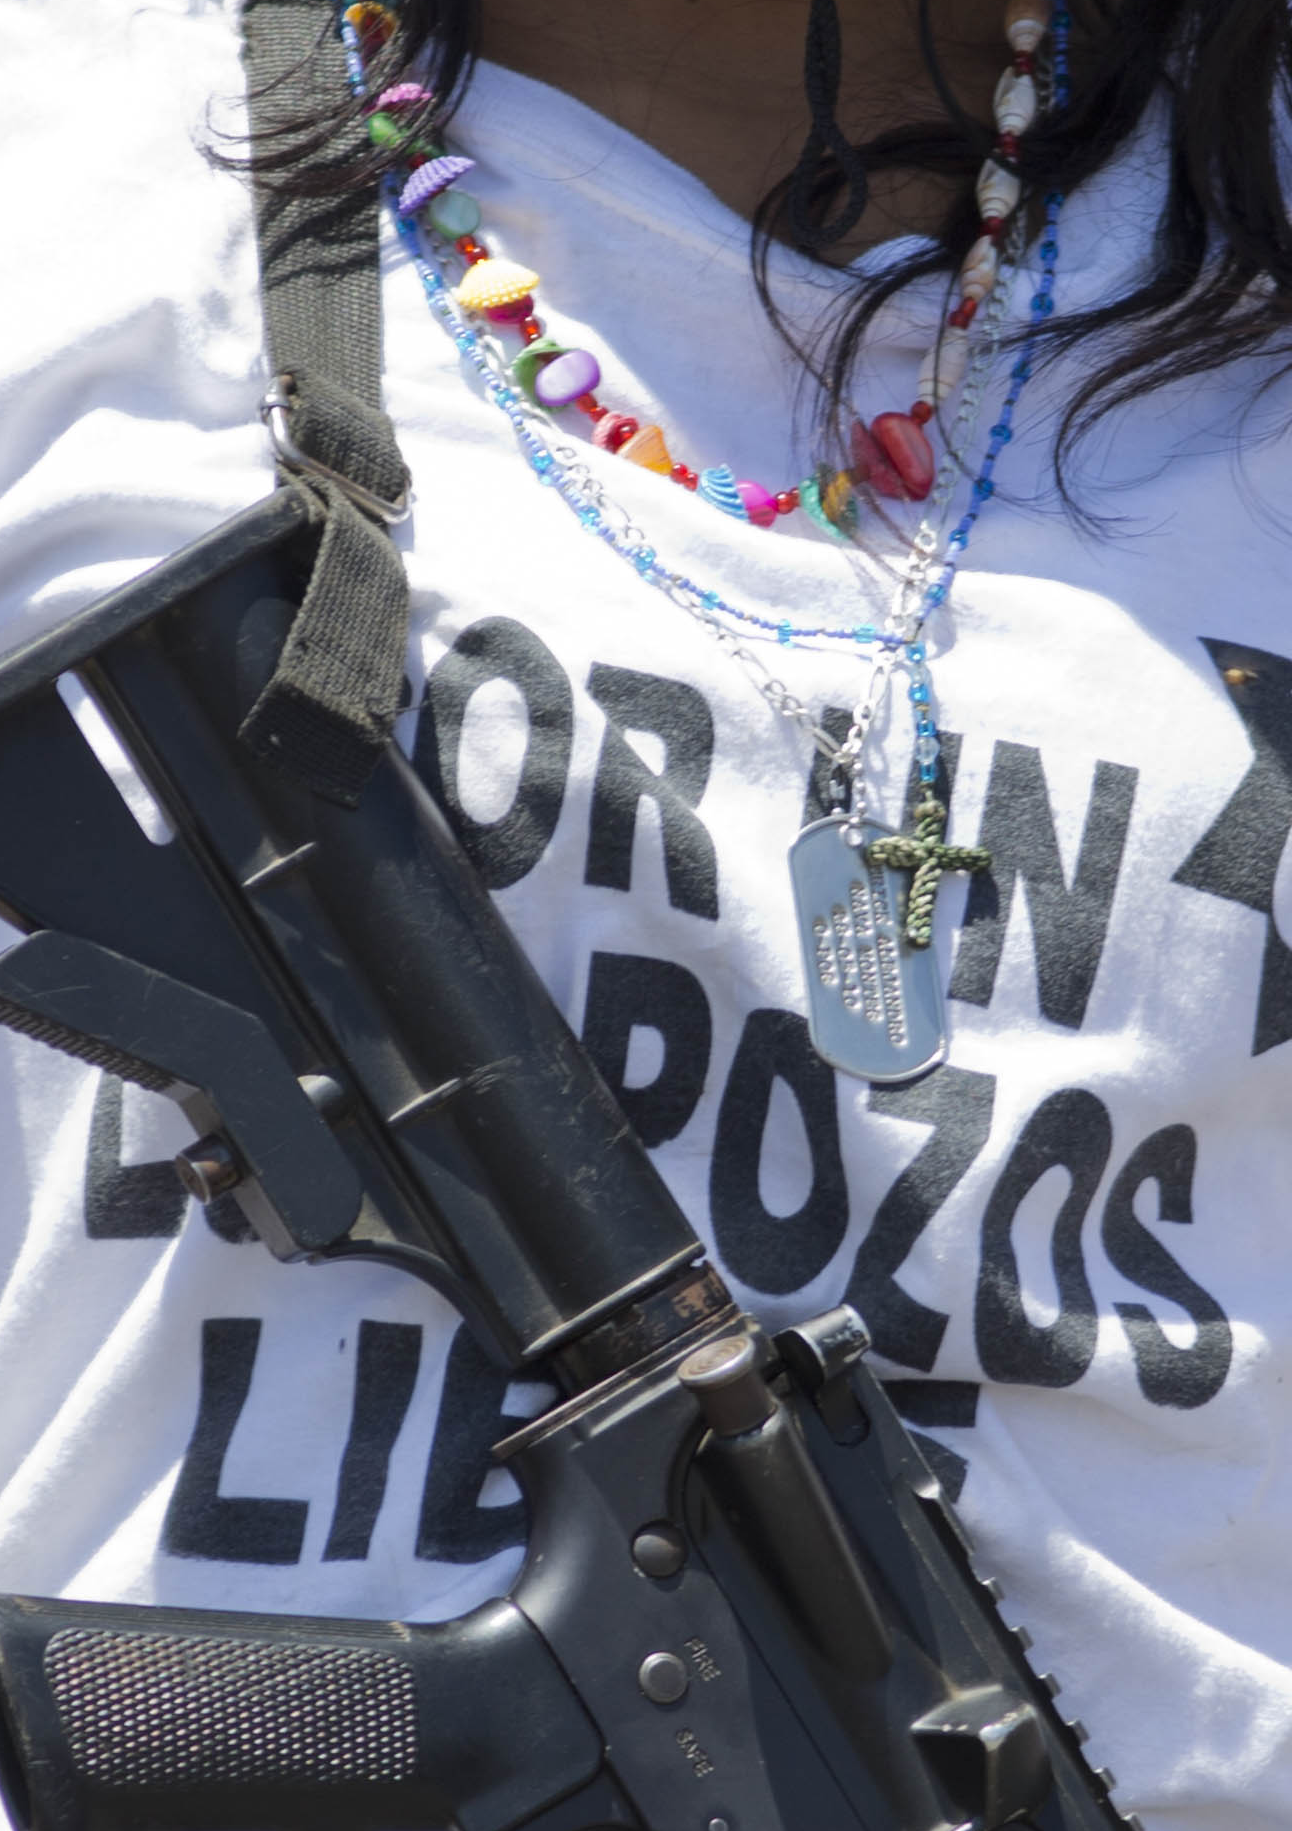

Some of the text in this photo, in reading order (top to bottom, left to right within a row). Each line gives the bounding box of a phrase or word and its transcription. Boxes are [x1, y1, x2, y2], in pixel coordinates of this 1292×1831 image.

[402, 616, 720, 921] OR
[580, 951, 1234, 1409] POZOS
[684, 1638, 722, 1681] FIRE
[676, 1729, 714, 1777] SAFE
